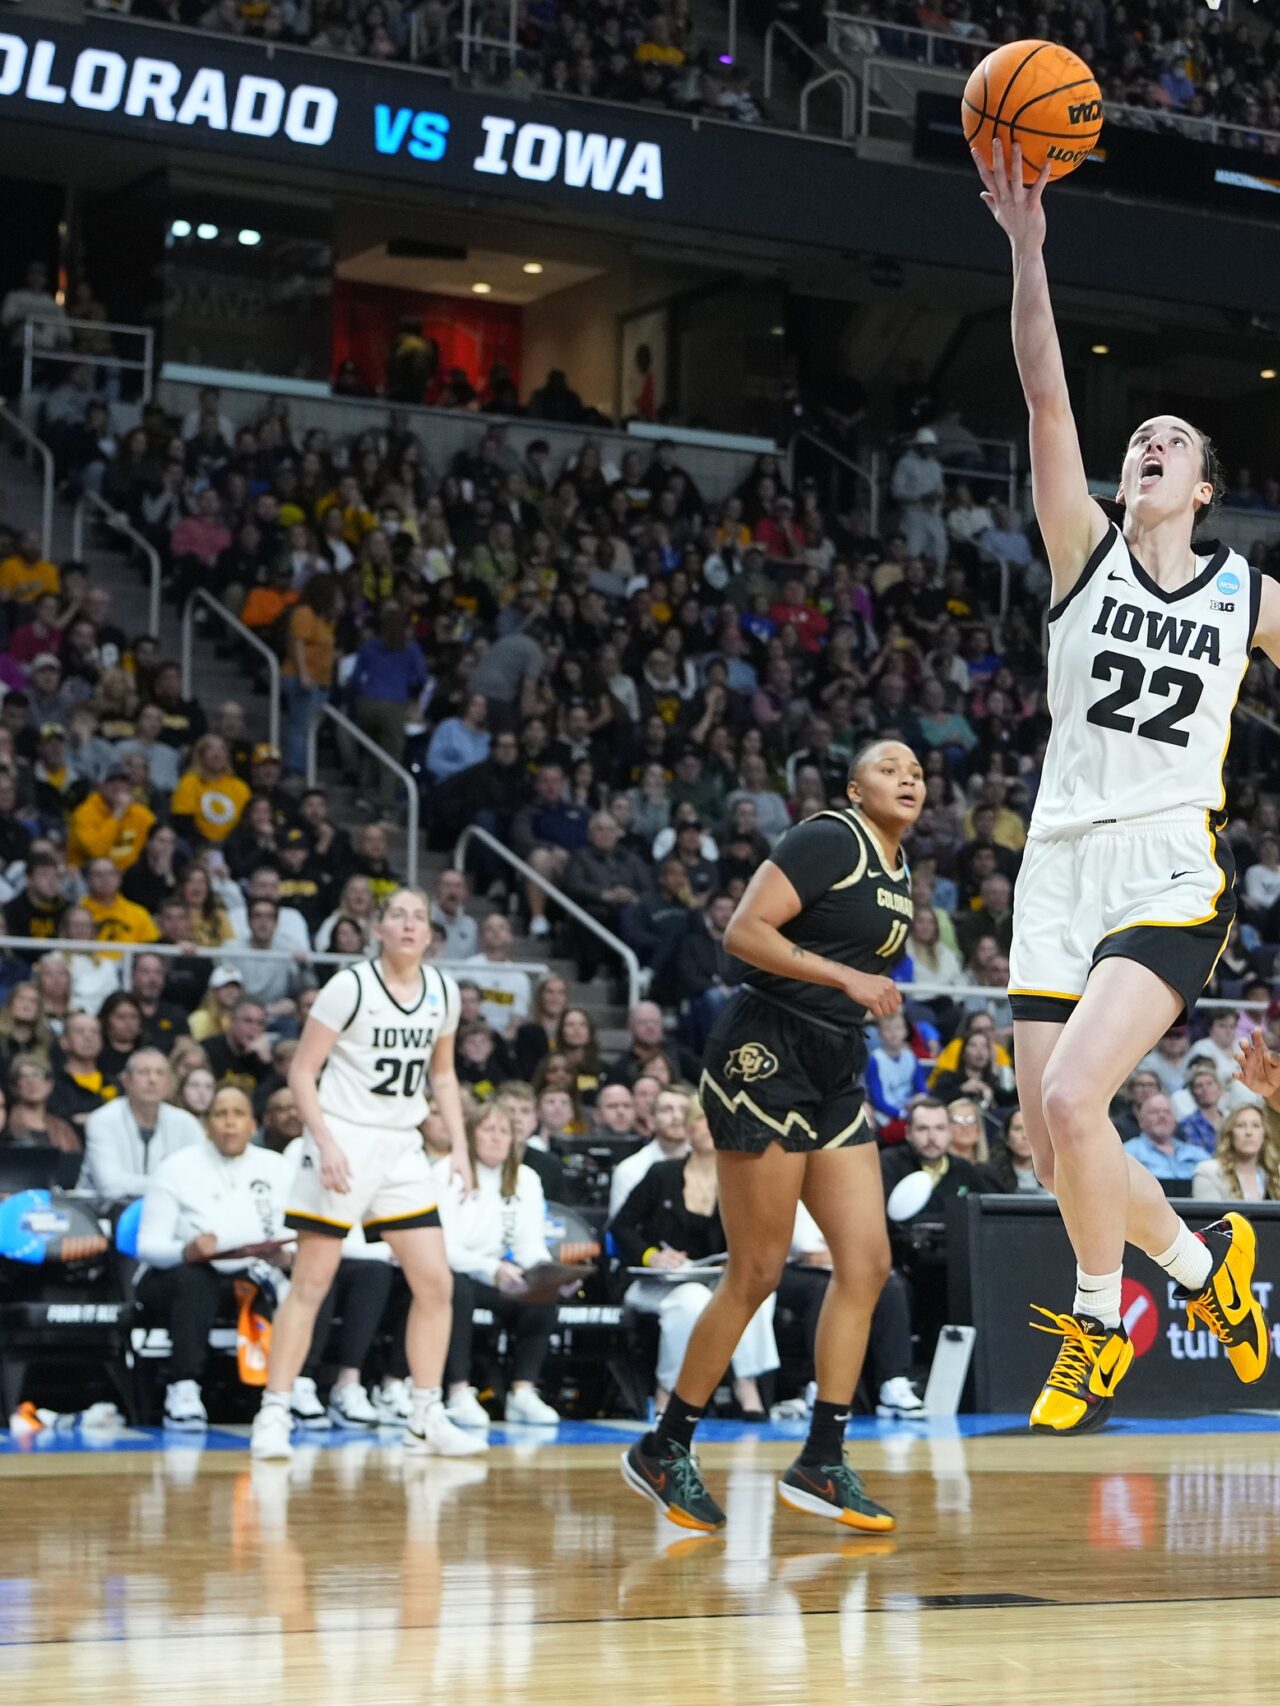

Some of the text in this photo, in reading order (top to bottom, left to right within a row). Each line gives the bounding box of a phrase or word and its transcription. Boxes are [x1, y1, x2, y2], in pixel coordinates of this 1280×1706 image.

[1069, 100, 1103, 125] CAA
[374, 103, 450, 162] VS
[473, 115, 664, 200] IOWA
[1091, 595, 1221, 666] IOWA
[1086, 649, 1204, 748] 22
[372, 1027, 433, 1049] IOWA
[370, 1057, 425, 1097] 20
